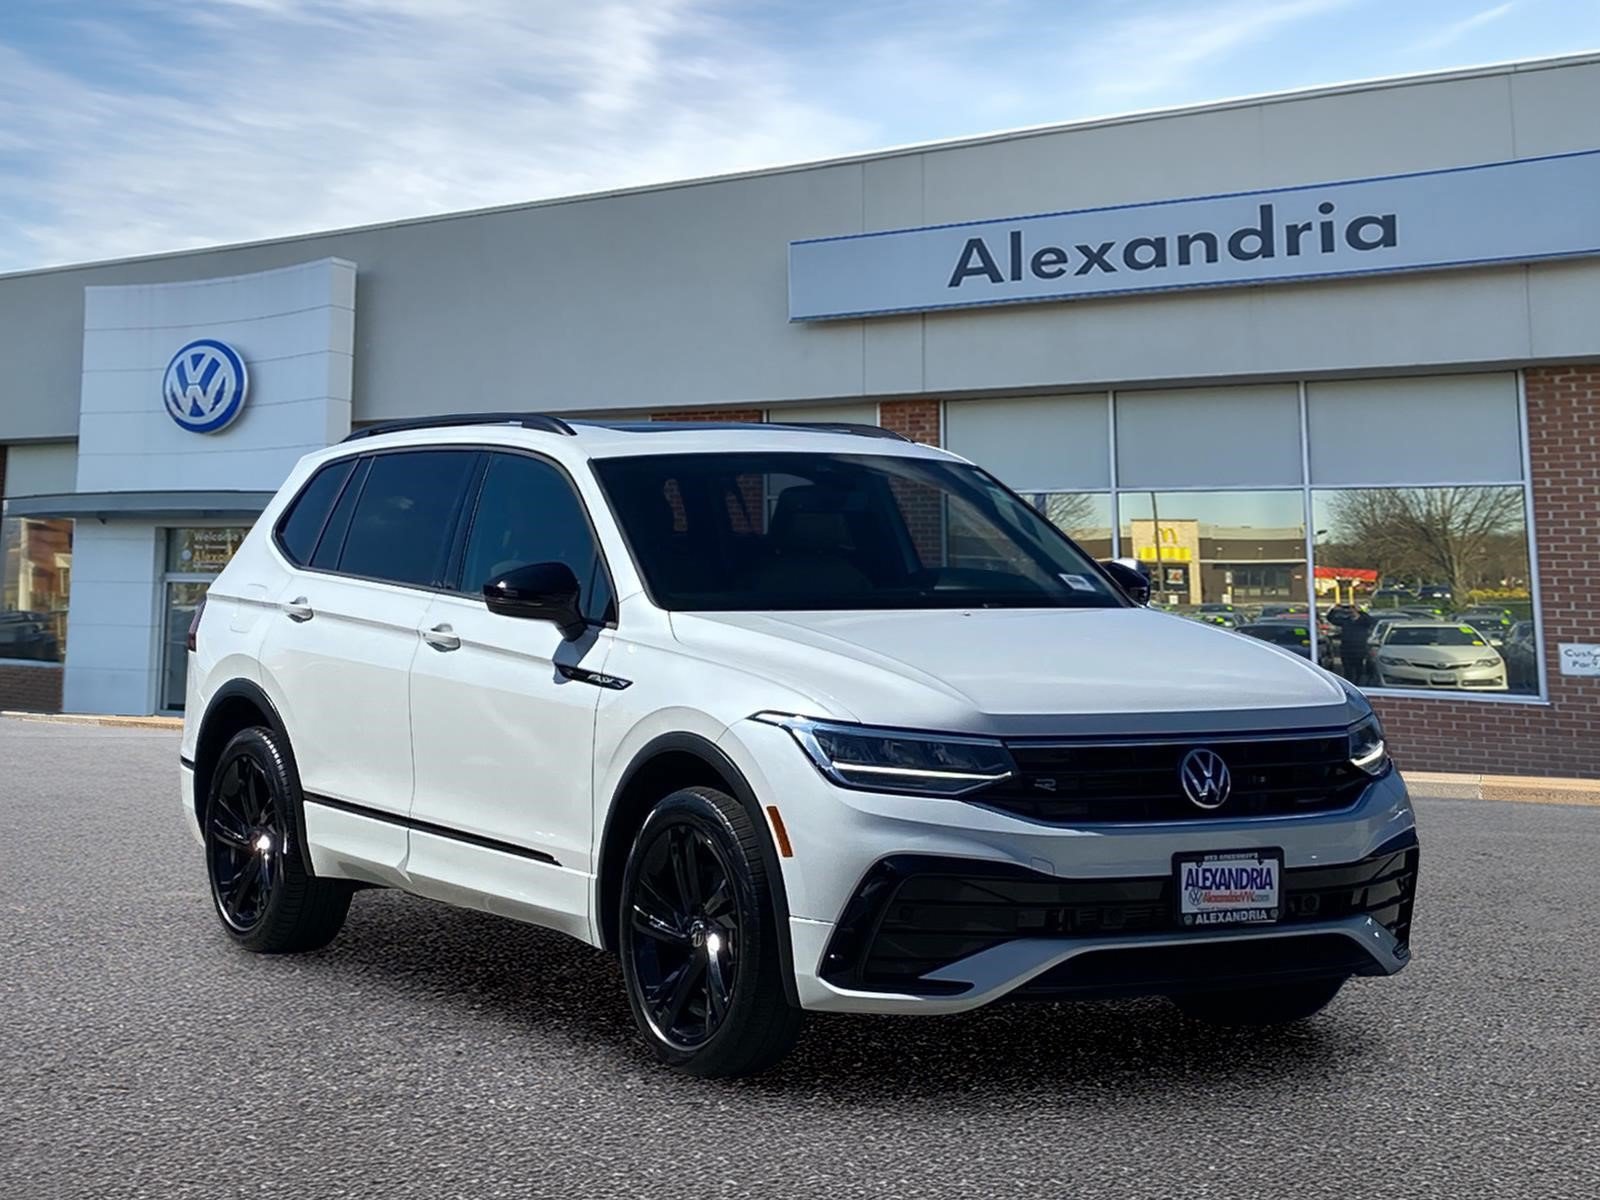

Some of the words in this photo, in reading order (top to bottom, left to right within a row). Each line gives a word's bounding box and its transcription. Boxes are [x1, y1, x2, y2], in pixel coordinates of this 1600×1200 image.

[948, 202, 1397, 288] Alexandria
[1184, 867, 1273, 891] ALEXANDRIA
[1195, 909, 1267, 925] ALEXANDRIA
